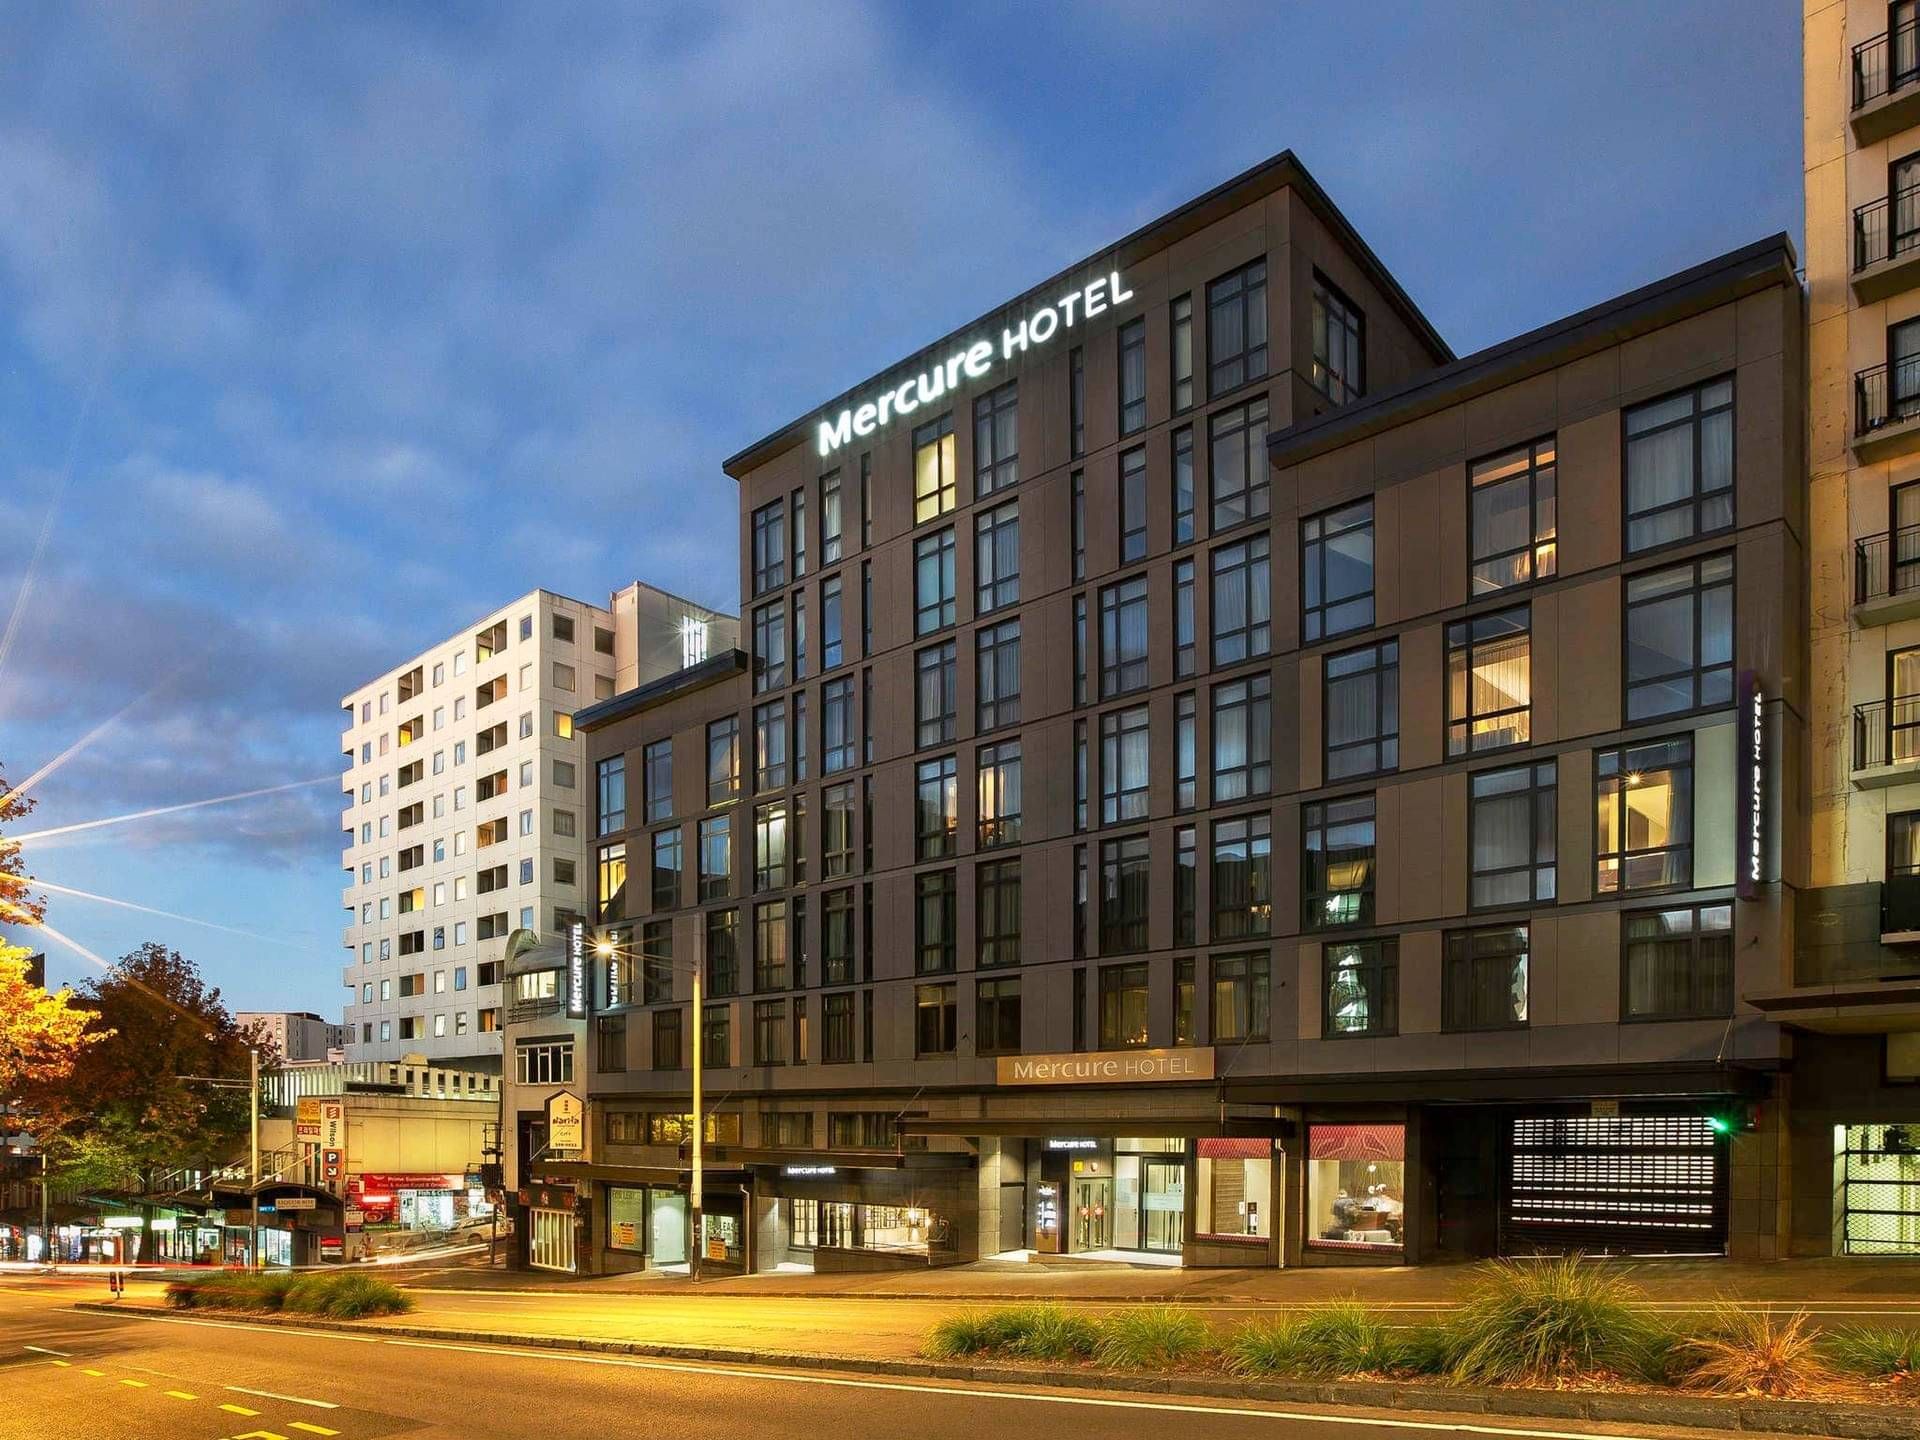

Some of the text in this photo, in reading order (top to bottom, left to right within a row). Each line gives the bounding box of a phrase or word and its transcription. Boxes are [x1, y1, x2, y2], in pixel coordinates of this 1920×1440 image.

[817, 271, 1134, 457] Mercure HOTEL
[1751, 692, 1762, 881] Mercure HOTEL
[571, 922, 583, 1013] Mercure HOTEL
[1013, 1057, 1195, 1079] Mercure HOTEL
[329, 1121, 337, 1147] Wilson
[1049, 1139, 1079, 1149] Mercure
[328, 1153, 337, 1162] P
